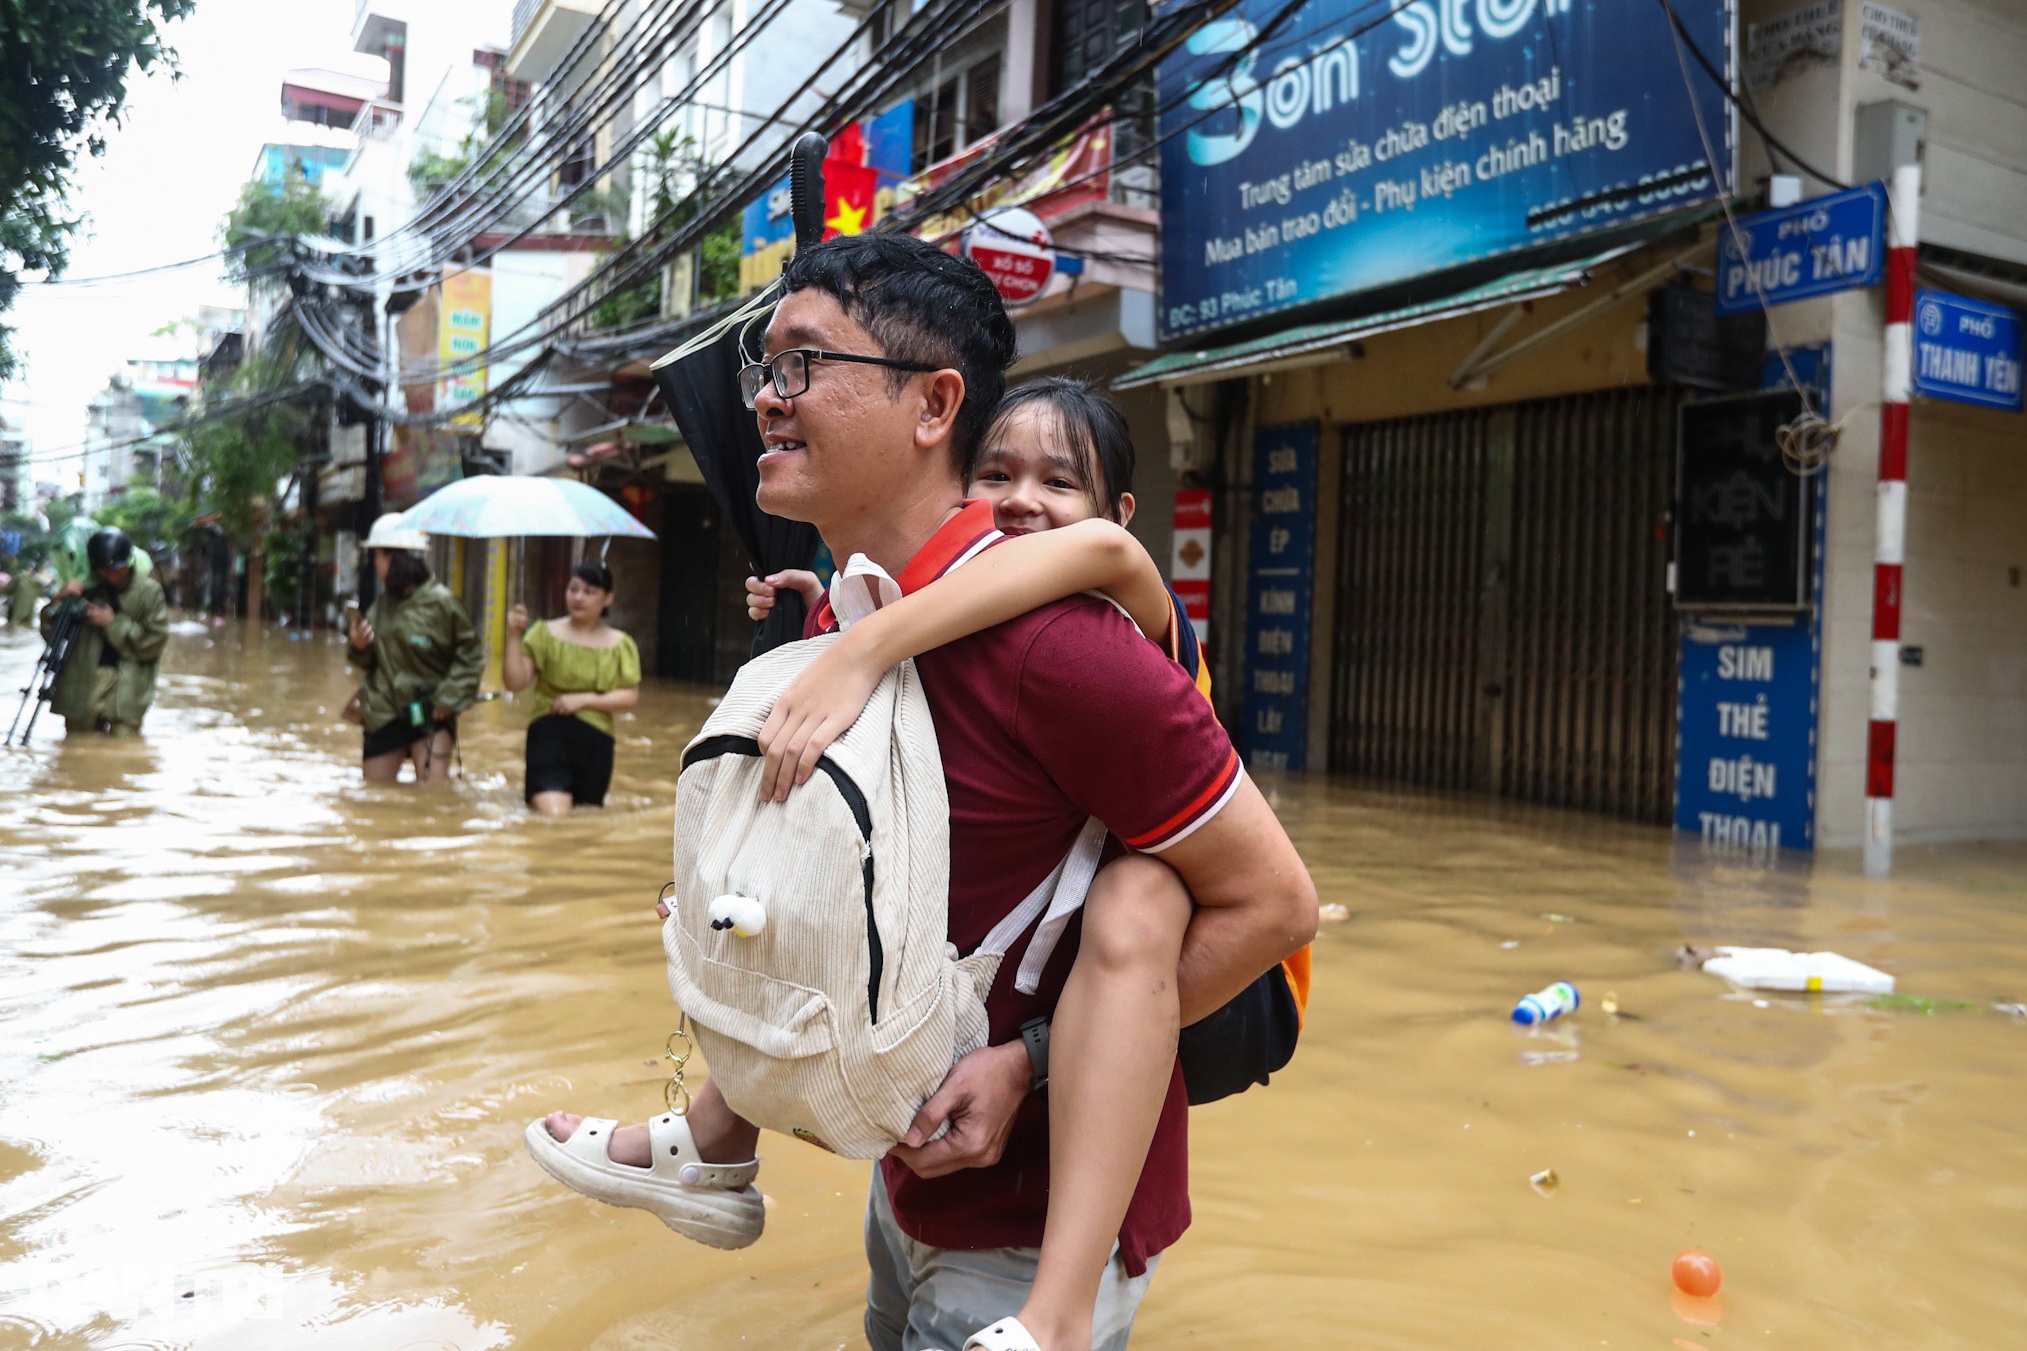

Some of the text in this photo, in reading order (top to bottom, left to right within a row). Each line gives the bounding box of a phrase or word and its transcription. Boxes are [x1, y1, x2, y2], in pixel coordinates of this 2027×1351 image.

[1239, 65, 1561, 210] Trung tâm sửa chữa điện thoại
[1204, 236, 1243, 268] Mua
[1244, 221, 1280, 255] bán
[1281, 210, 1320, 243] trao
[1322, 186, 1358, 230] đổi
[1374, 178, 1417, 213] Phụ
[1420, 159, 1472, 200] kiện
[1475, 130, 1548, 182] chính
[1553, 108, 1629, 158] hãng
[1778, 212, 1830, 241] PHỐ
[1727, 235, 1870, 299] PHÚC TÂN
[1221, 286, 1262, 315] Phúc
[1265, 277, 1298, 302] Tân
[1958, 314, 1996, 340] PHỐ
[1919, 341, 2019, 394] THANH YÊN
[1269, 525, 1291, 555] ÉP
[1717, 646, 1774, 682] SIM
[1717, 695, 1769, 742] THẺ
[1708, 756, 1777, 803] ĐIỆN
